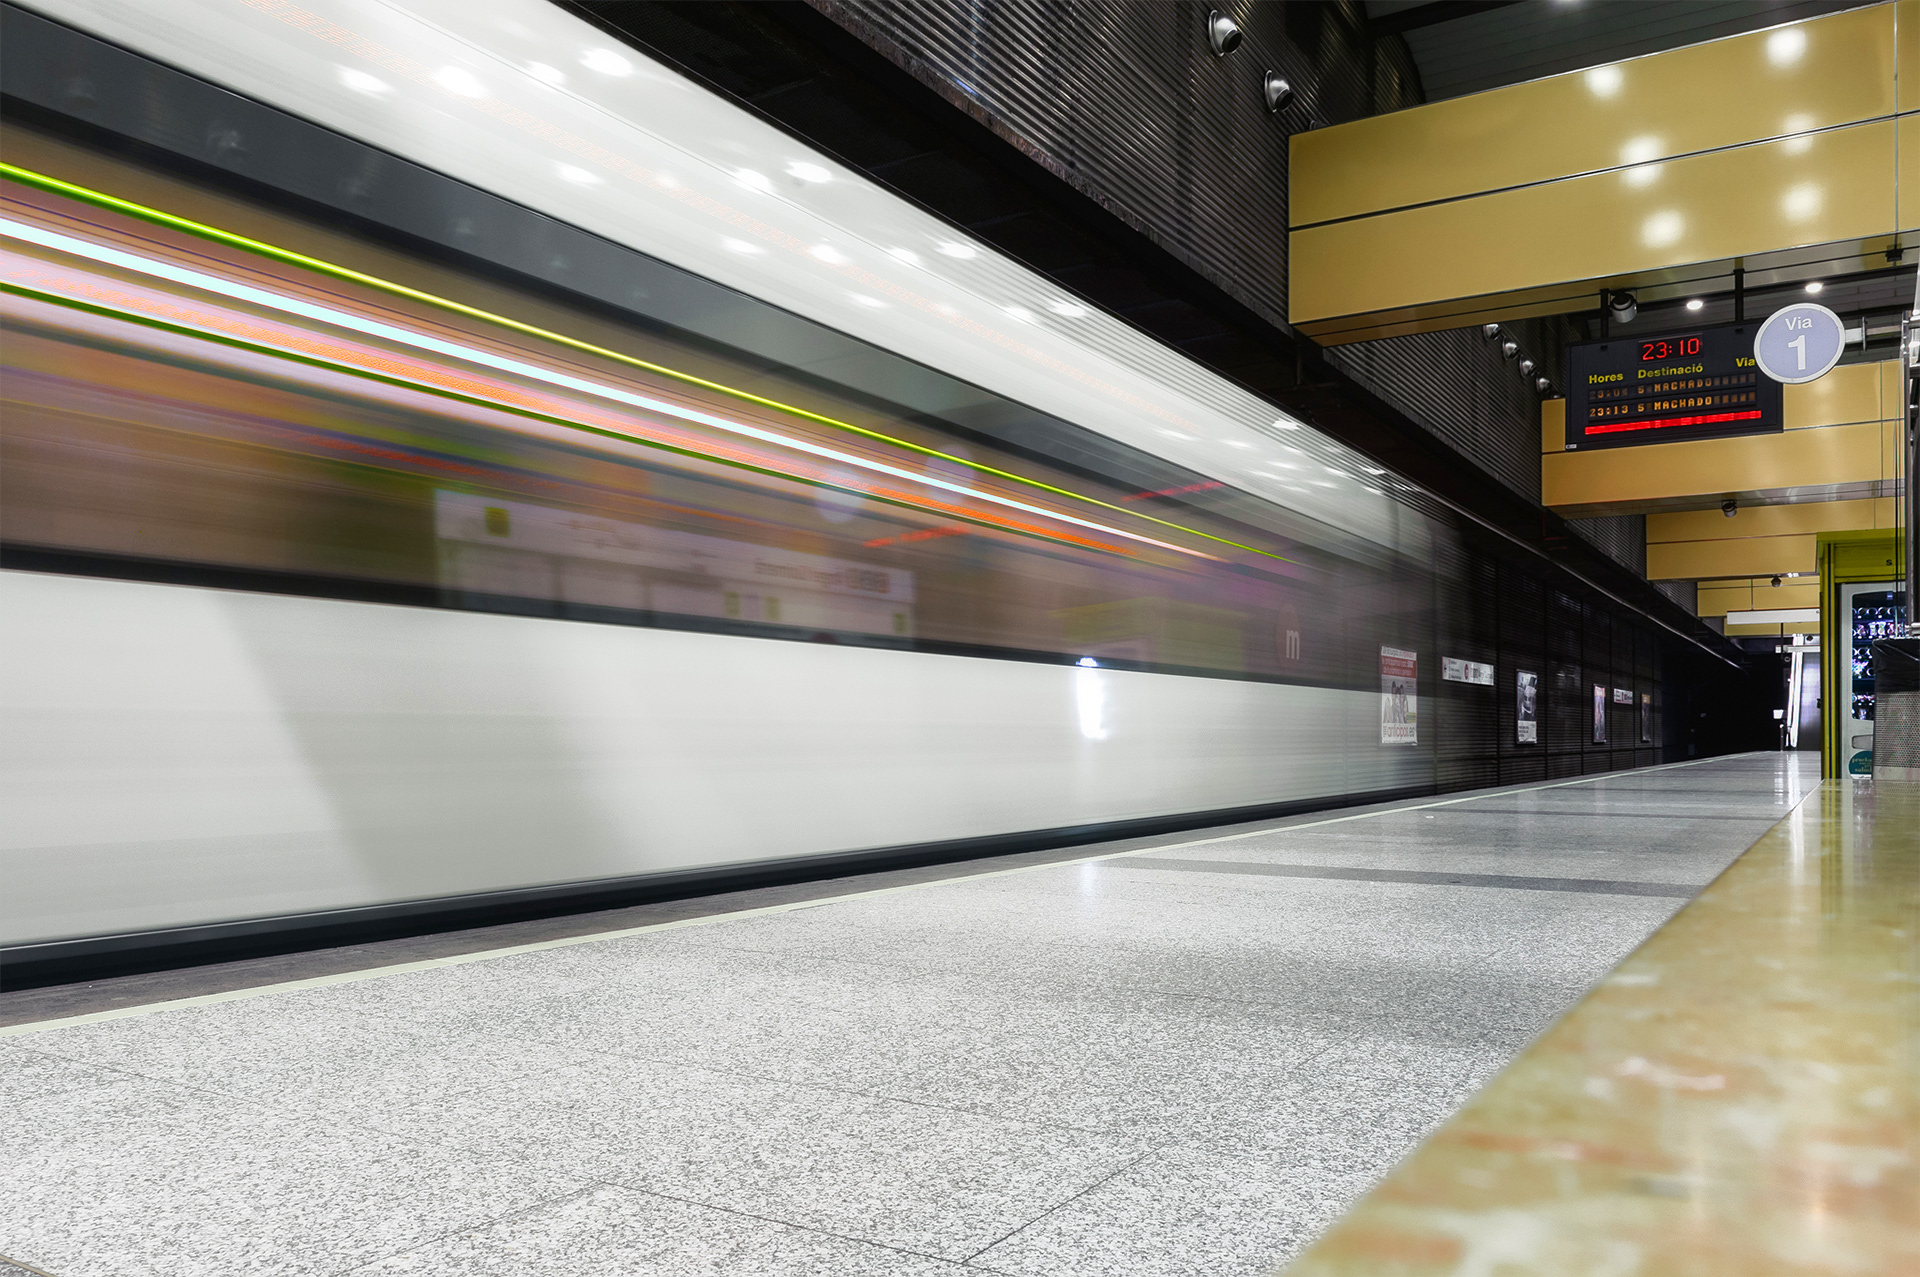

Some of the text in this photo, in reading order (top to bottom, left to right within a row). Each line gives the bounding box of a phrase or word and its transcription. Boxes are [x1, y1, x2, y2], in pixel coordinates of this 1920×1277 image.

[1785, 316, 1813, 331] Via
[1642, 337, 1700, 361] 23:10
[1788, 334, 1806, 370] 1
[1588, 357, 1756, 384] Hores Destinació Via
[1654, 377, 1712, 393] MACHADO
[1589, 396, 1712, 417] 23:13 5 MACHADO
